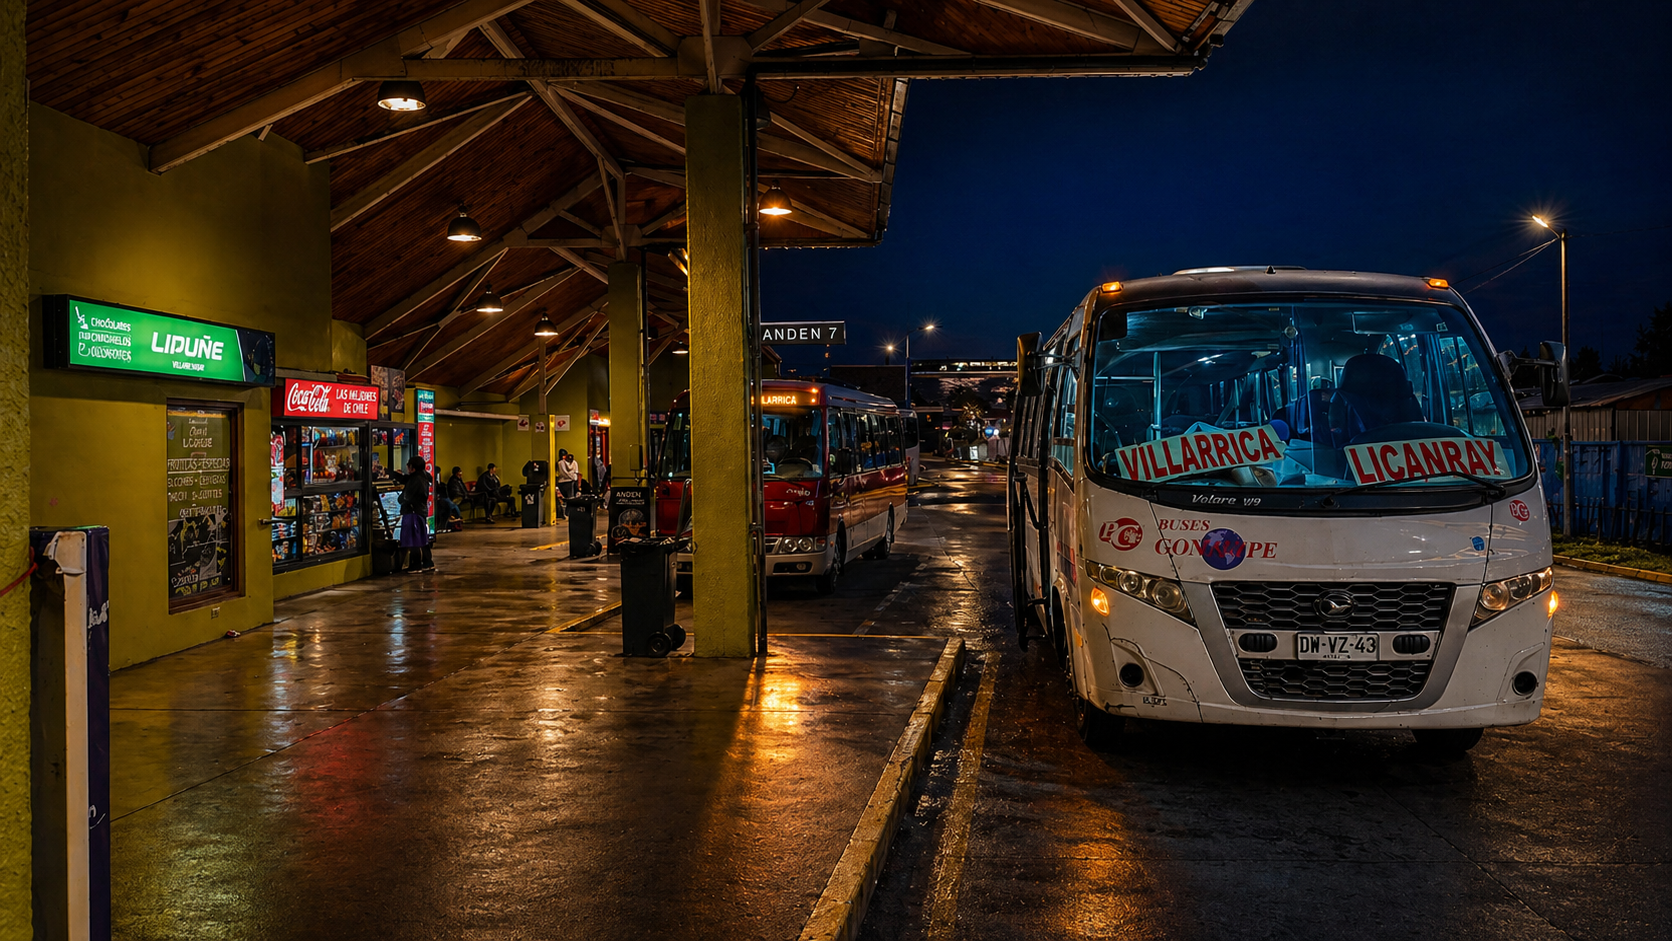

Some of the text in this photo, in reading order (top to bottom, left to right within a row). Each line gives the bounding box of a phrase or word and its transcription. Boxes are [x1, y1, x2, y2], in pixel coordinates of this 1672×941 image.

[762, 327, 837, 341] ANDEN 7
[336, 389, 348, 400] LAS
[343, 402, 351, 414] DE
[1119, 428, 1281, 481] VILLARRICA
[1348, 440, 1500, 484] LICANRAY
[1192, 494, 1236, 505] Volare
[1159, 519, 1210, 531] BUSES
